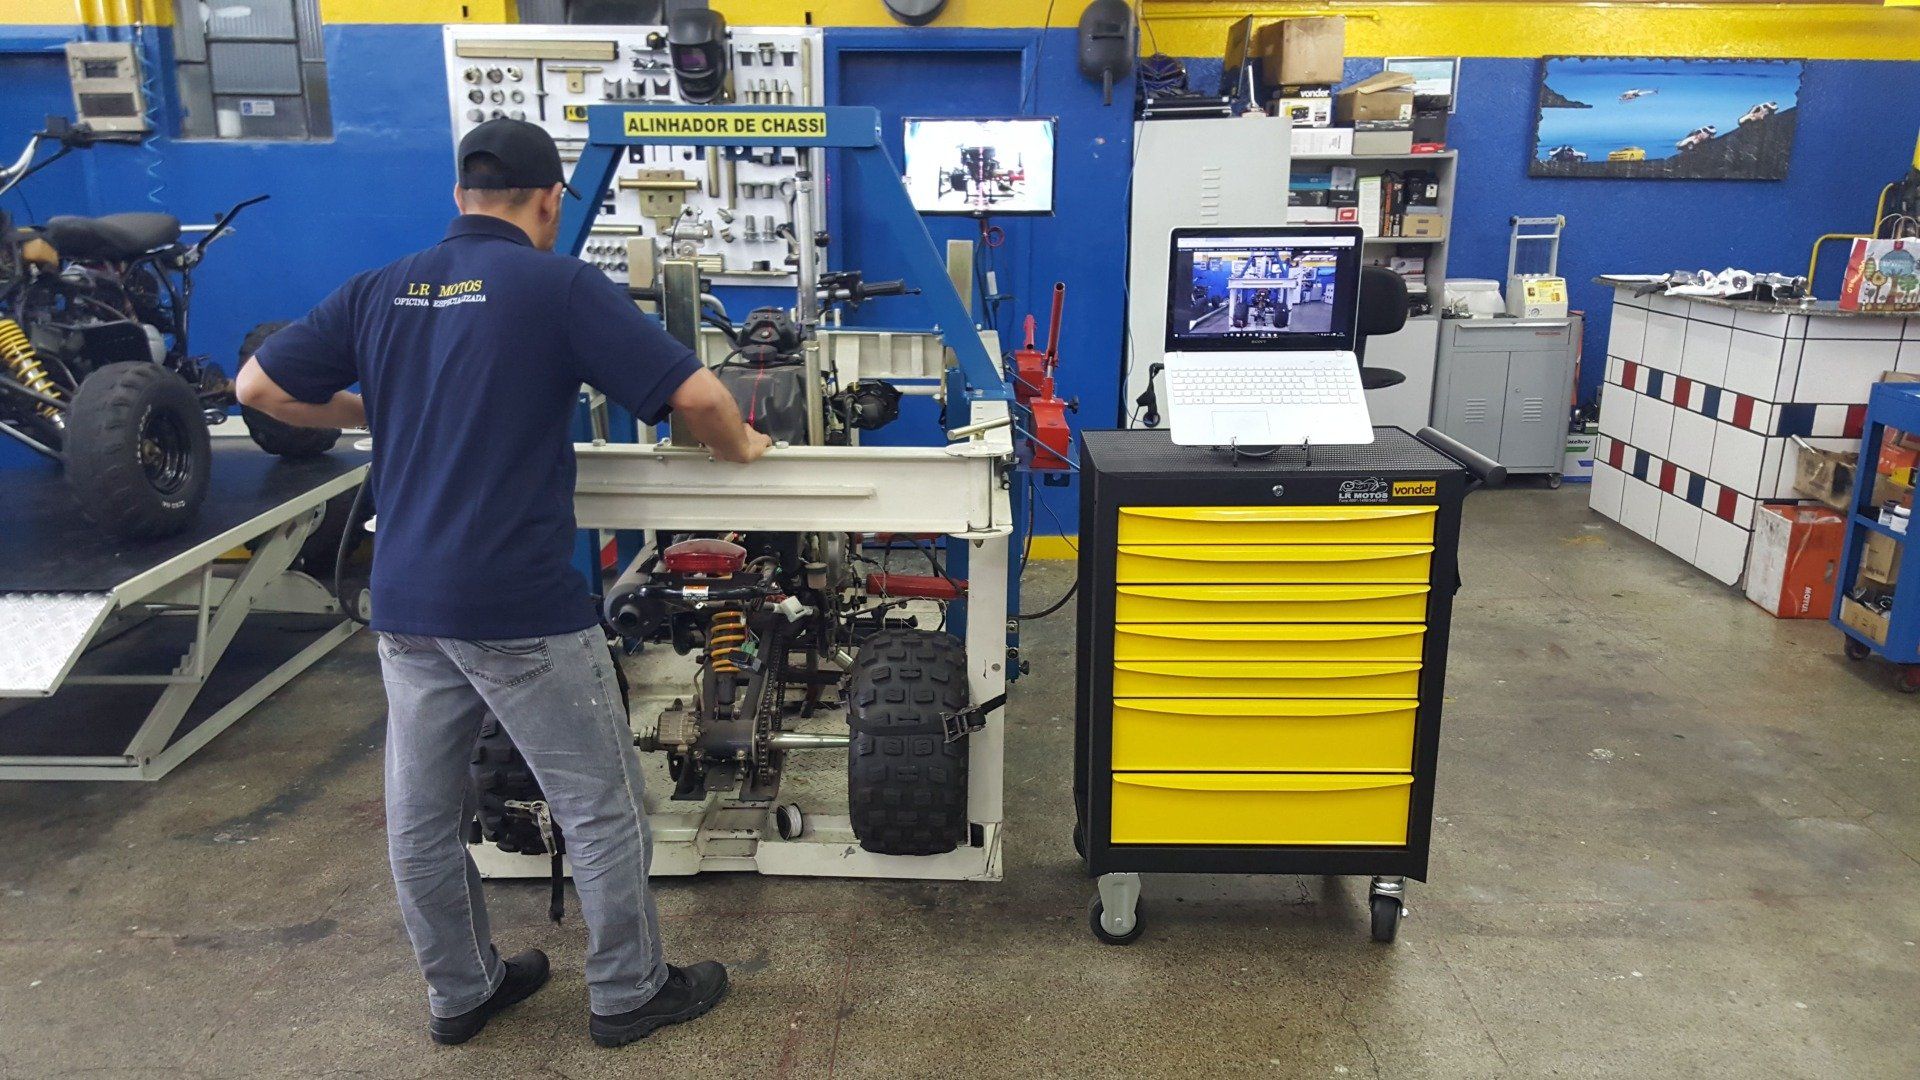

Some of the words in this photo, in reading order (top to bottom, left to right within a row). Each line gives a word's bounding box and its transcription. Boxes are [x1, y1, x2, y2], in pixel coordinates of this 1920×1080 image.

[1300, 88, 1330, 98] vonder
[628, 118, 729, 133] ALINHADOR
[734, 118, 756, 133] DE
[761, 118, 825, 133] CHASSI
[408, 283, 430, 296] LR
[438, 280, 482, 297] MOTOS
[394, 298, 430, 307] OFICINA
[433, 294, 487, 308] ESPECIALIZADA
[1394, 484, 1435, 495] vonder
[1801, 586, 1813, 613] MOTUL
